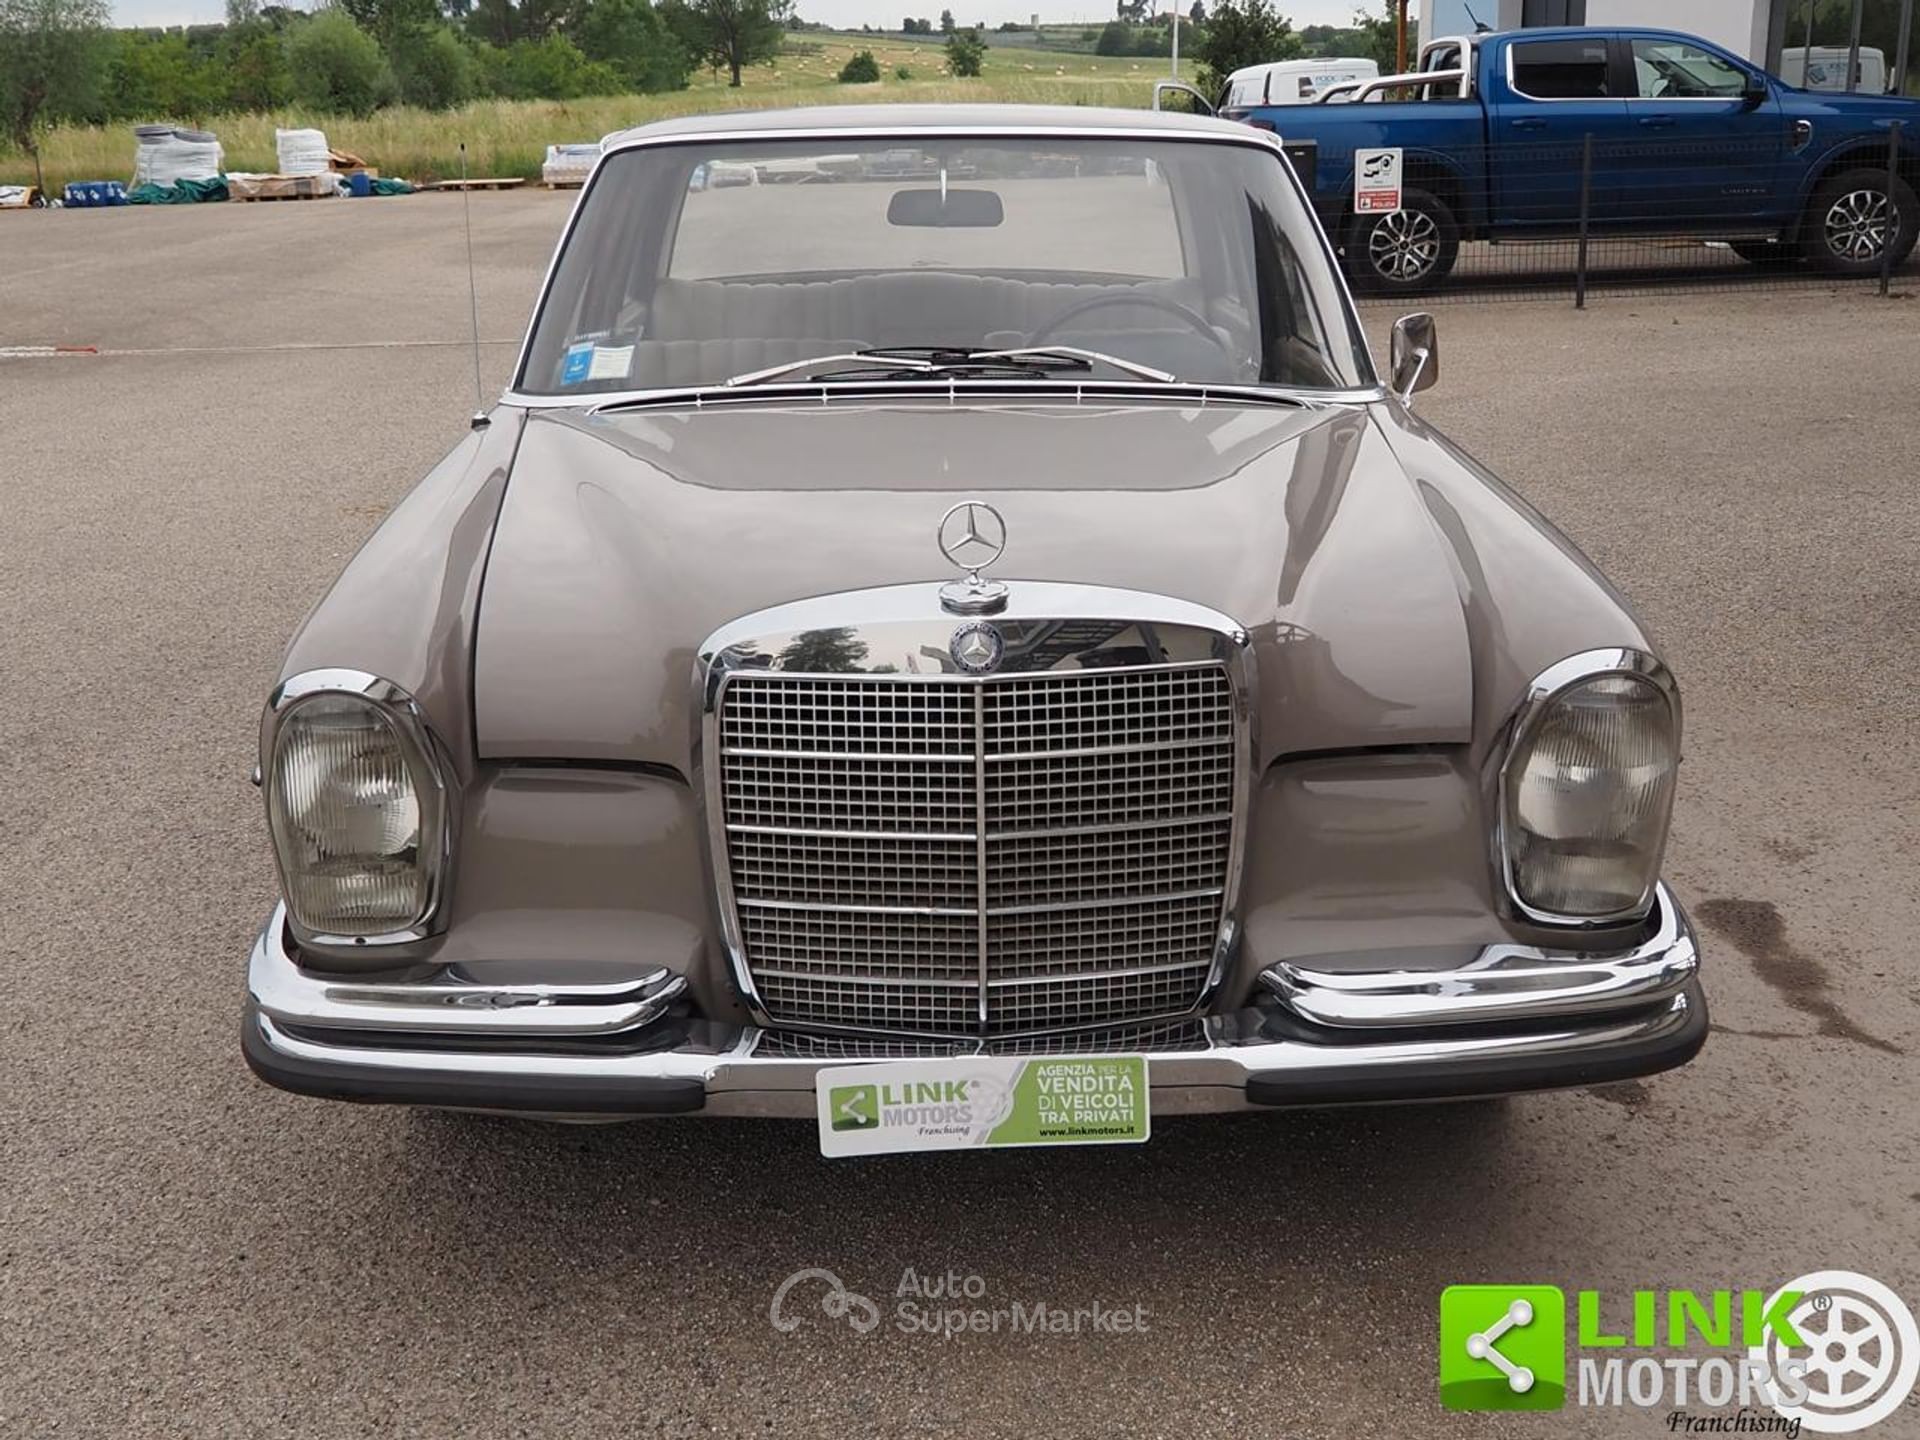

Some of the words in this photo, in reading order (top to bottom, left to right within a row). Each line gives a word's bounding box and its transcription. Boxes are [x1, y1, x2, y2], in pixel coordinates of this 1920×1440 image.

[1037, 1065, 1096, 1076] AGENZIA
[1119, 1064, 1132, 1075] LA
[882, 1080, 969, 1106] LINK
[1037, 1075, 1133, 1094] VENDITA
[1038, 1095, 1056, 1110] DI
[1060, 1093, 1134, 1110] VEICOLI
[883, 1105, 973, 1127] MOTORS
[1038, 1111, 1069, 1124] TRA
[1074, 1109, 1134, 1123] PRIVATI
[1039, 1125, 1135, 1137] www.linkmotors.it
